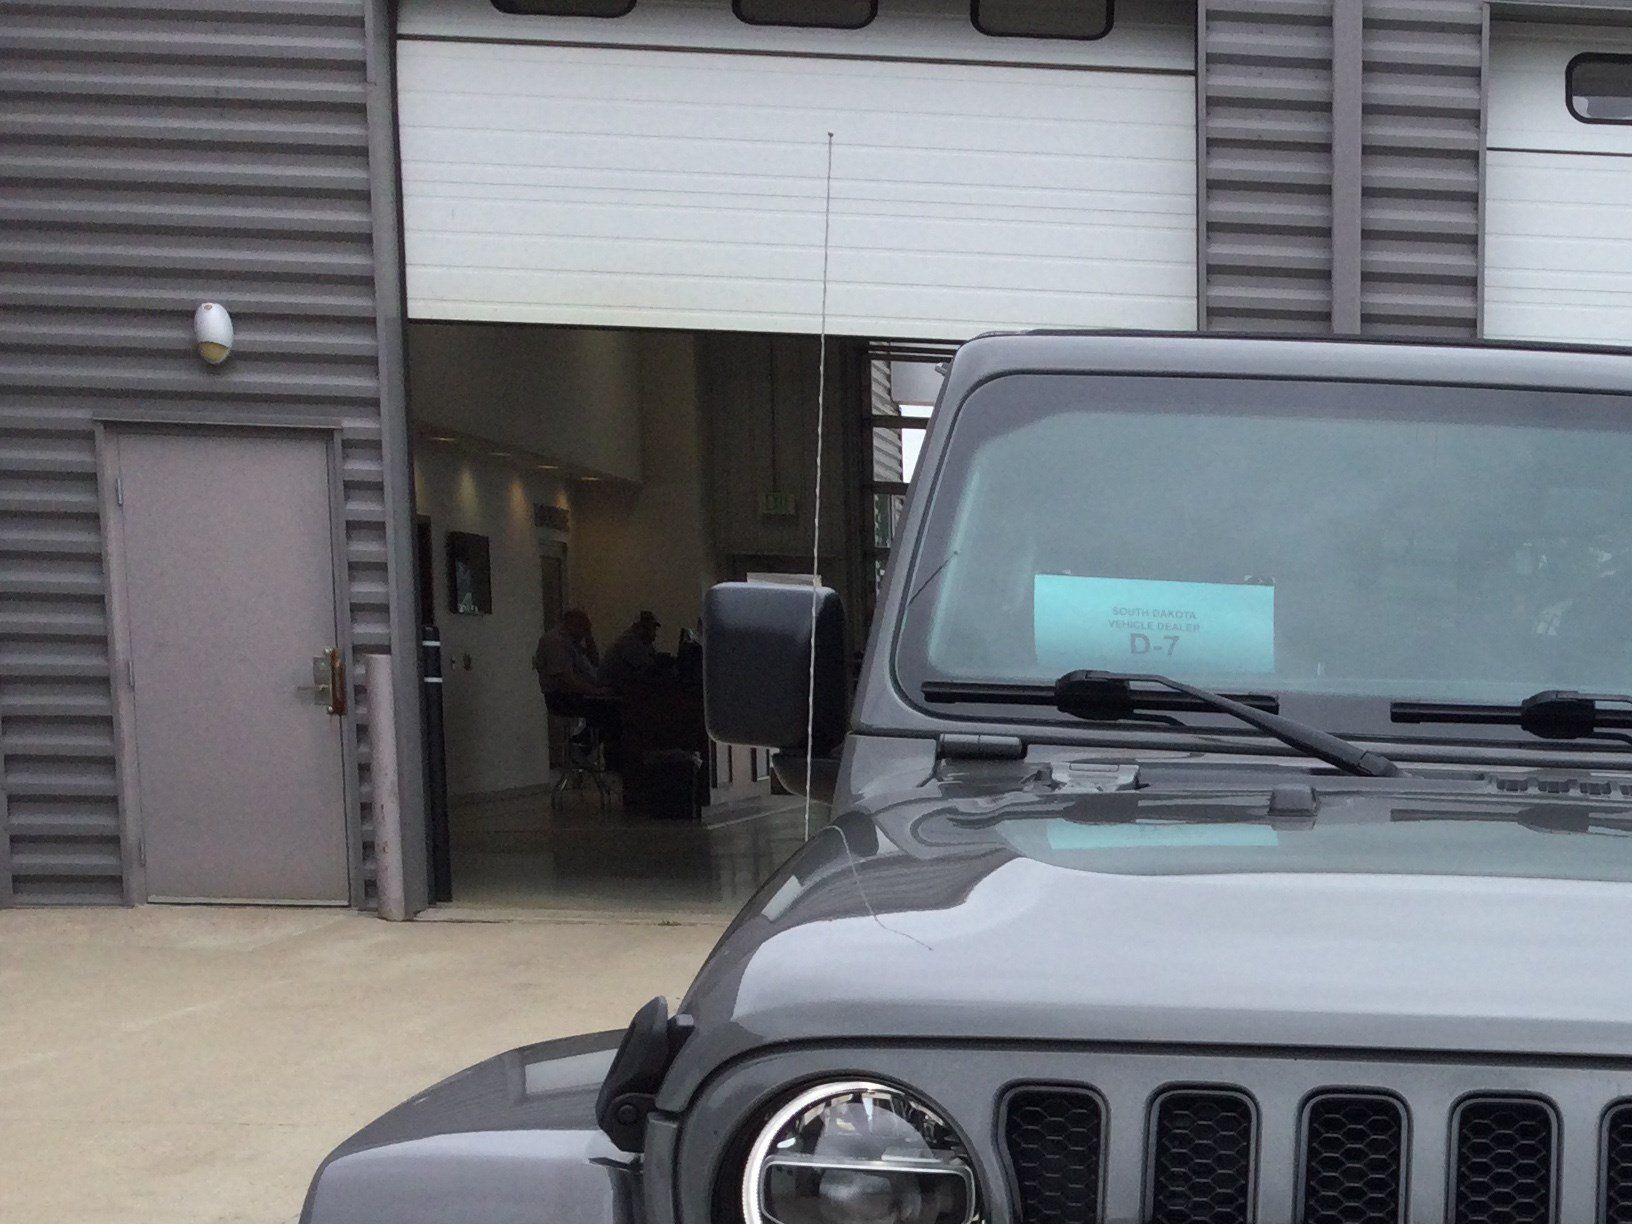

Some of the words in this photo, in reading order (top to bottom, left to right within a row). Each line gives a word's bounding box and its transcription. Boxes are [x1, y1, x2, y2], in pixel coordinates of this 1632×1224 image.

[1112, 607, 1149, 617] SOUTH
[1152, 608, 1197, 620] DAKOTA
[1130, 633, 1180, 656] D-7
